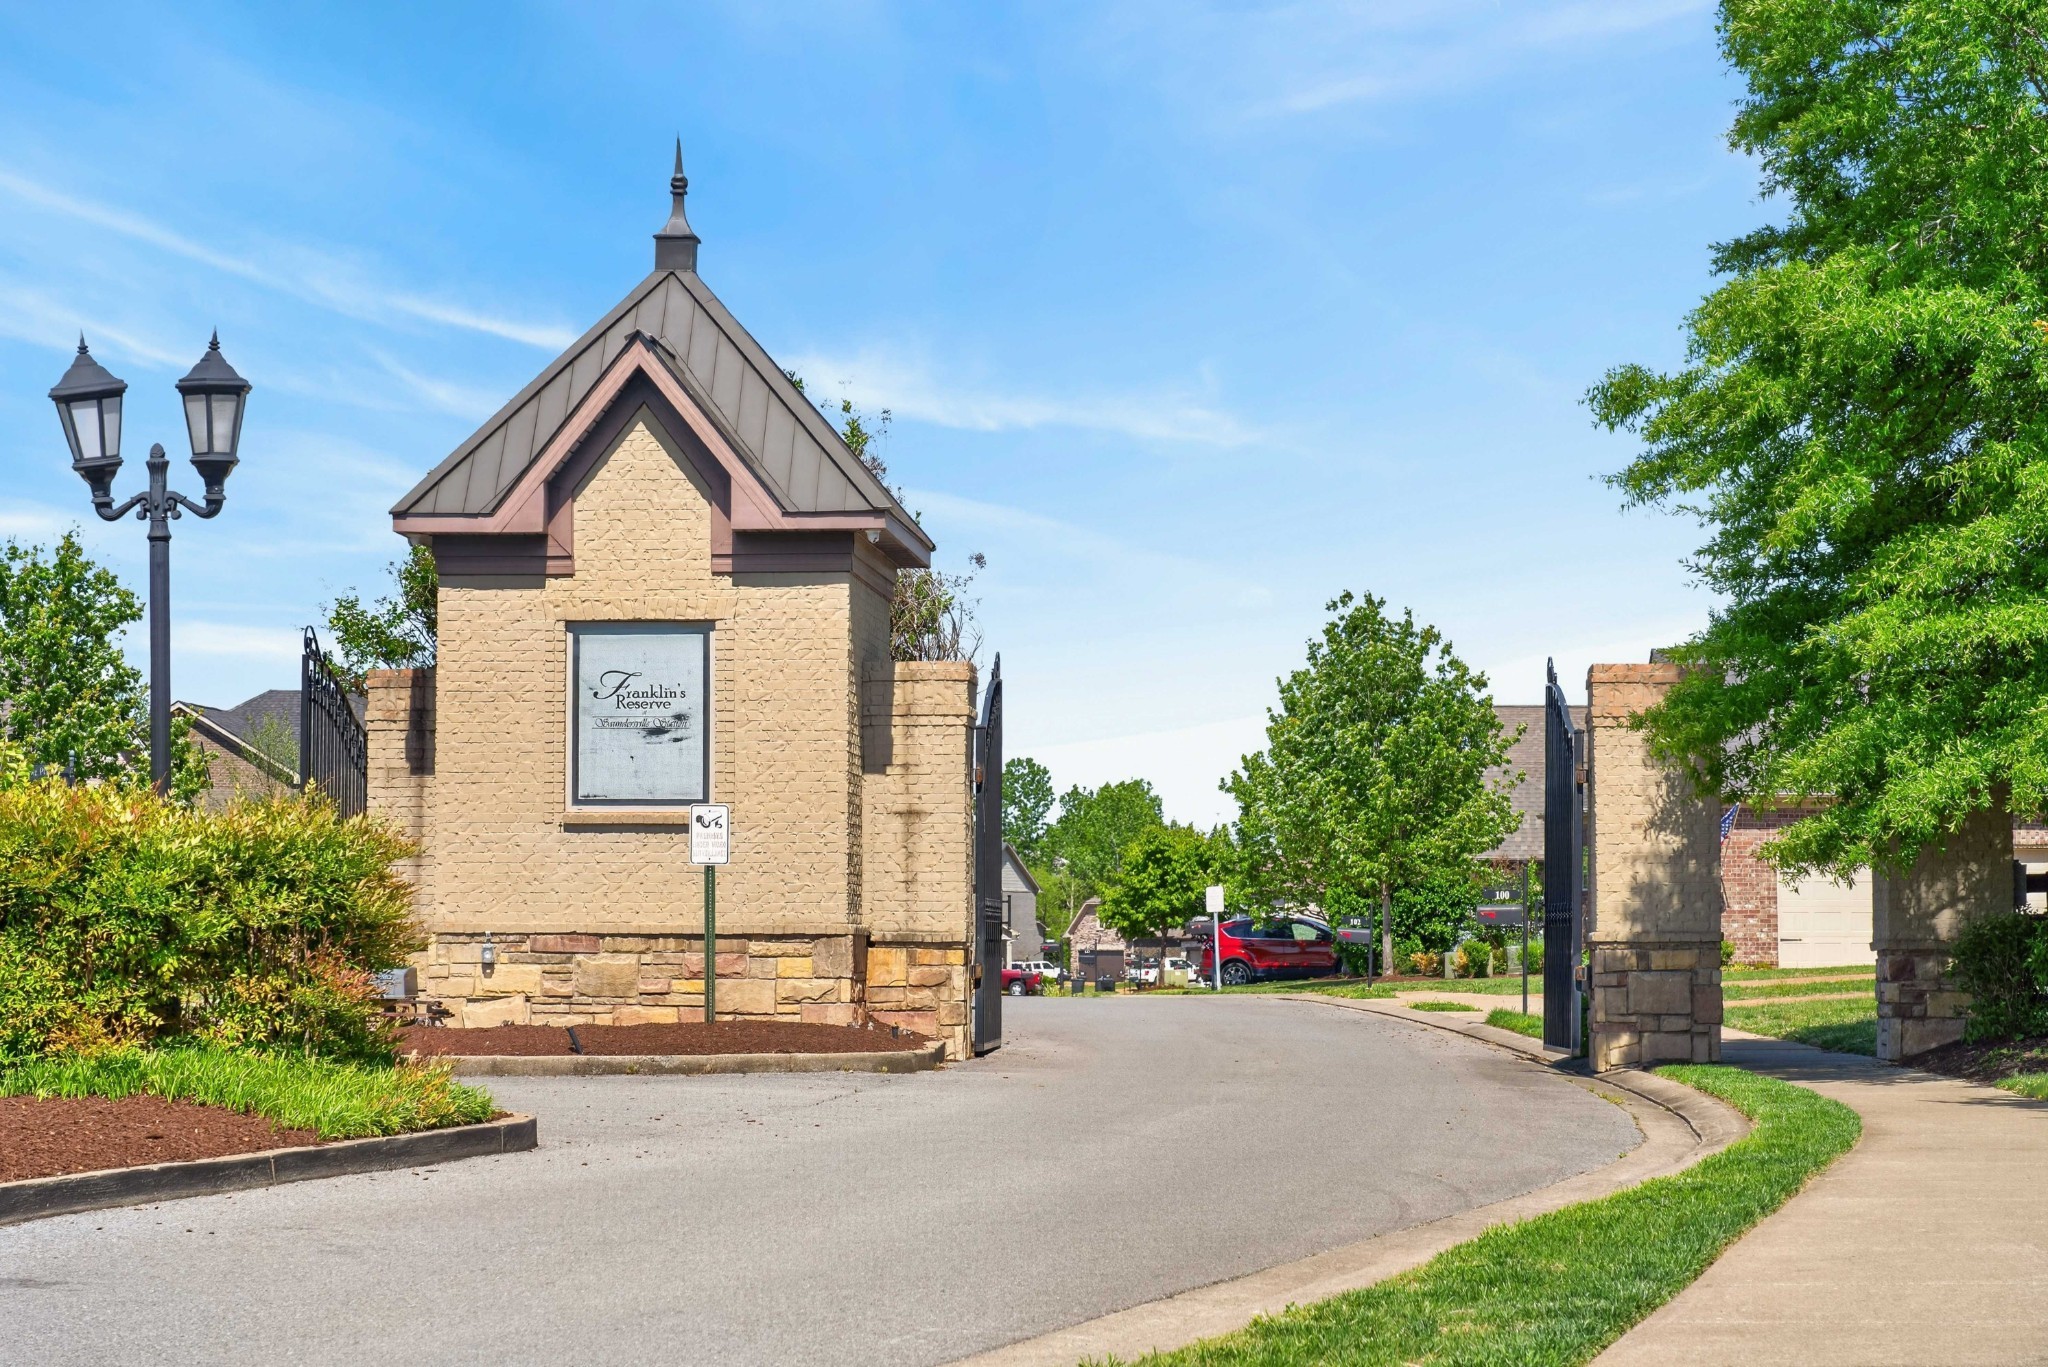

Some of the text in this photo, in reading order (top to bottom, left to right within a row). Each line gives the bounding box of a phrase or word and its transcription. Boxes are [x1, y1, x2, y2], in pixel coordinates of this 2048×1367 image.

[593, 670, 686, 700] Franklin's
[615, 694, 672, 710] Reserve
[1495, 891, 1510, 900] 100
